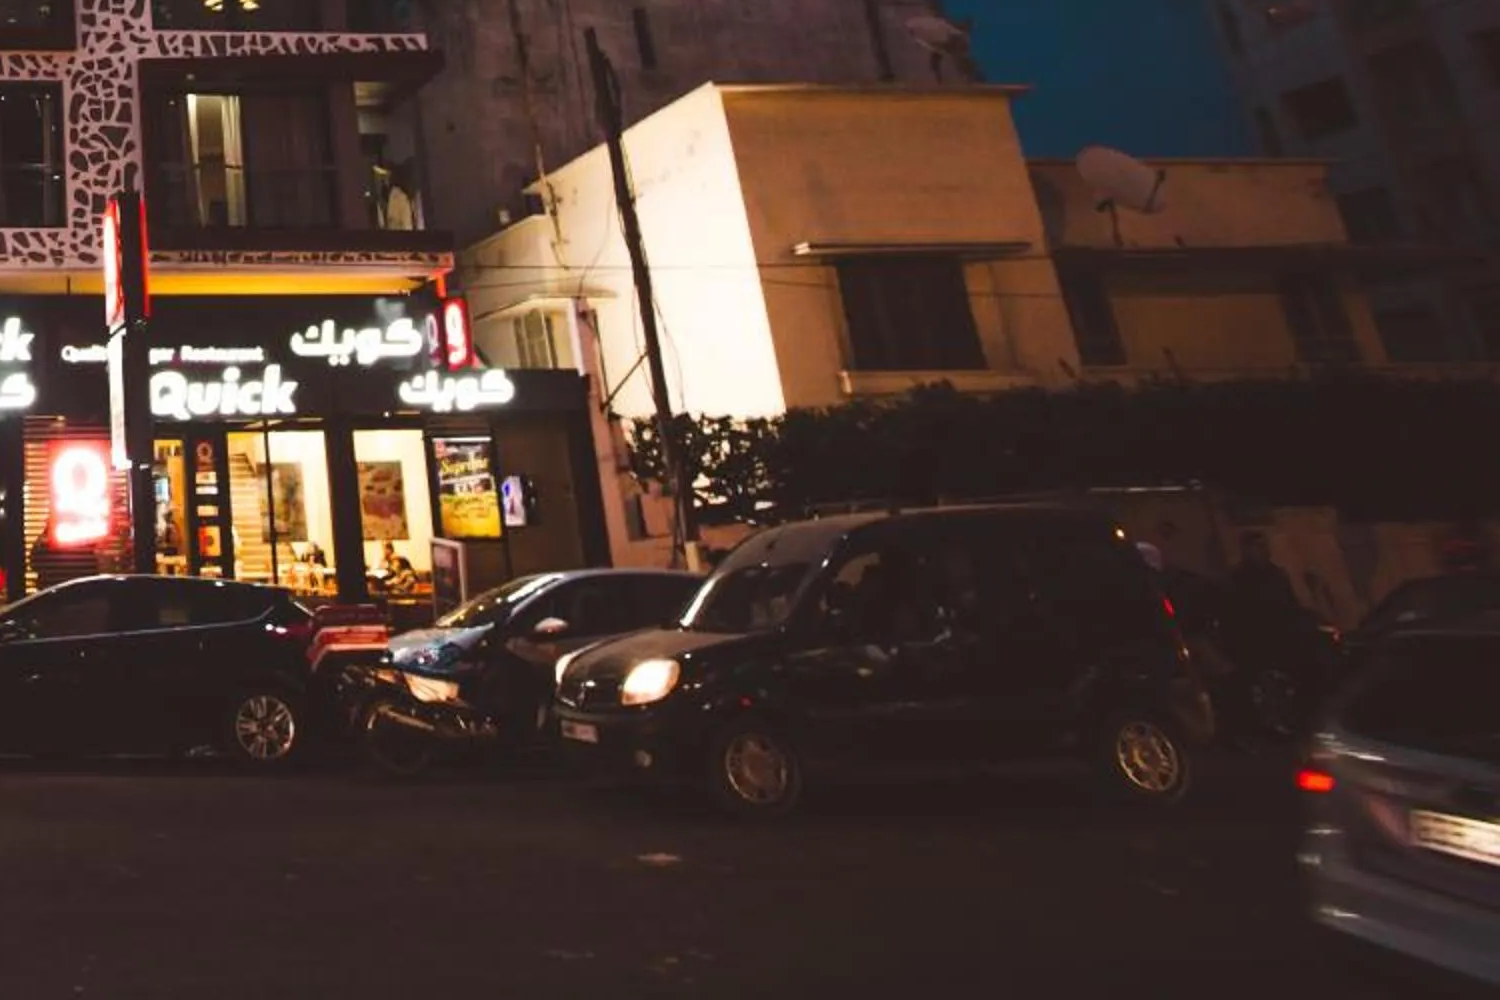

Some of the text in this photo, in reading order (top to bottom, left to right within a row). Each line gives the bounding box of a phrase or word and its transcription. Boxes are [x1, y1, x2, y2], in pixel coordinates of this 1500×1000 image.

[290, 317, 423, 365] كويك
[150, 364, 298, 420] Quick
[400, 369, 515, 412] كويك
